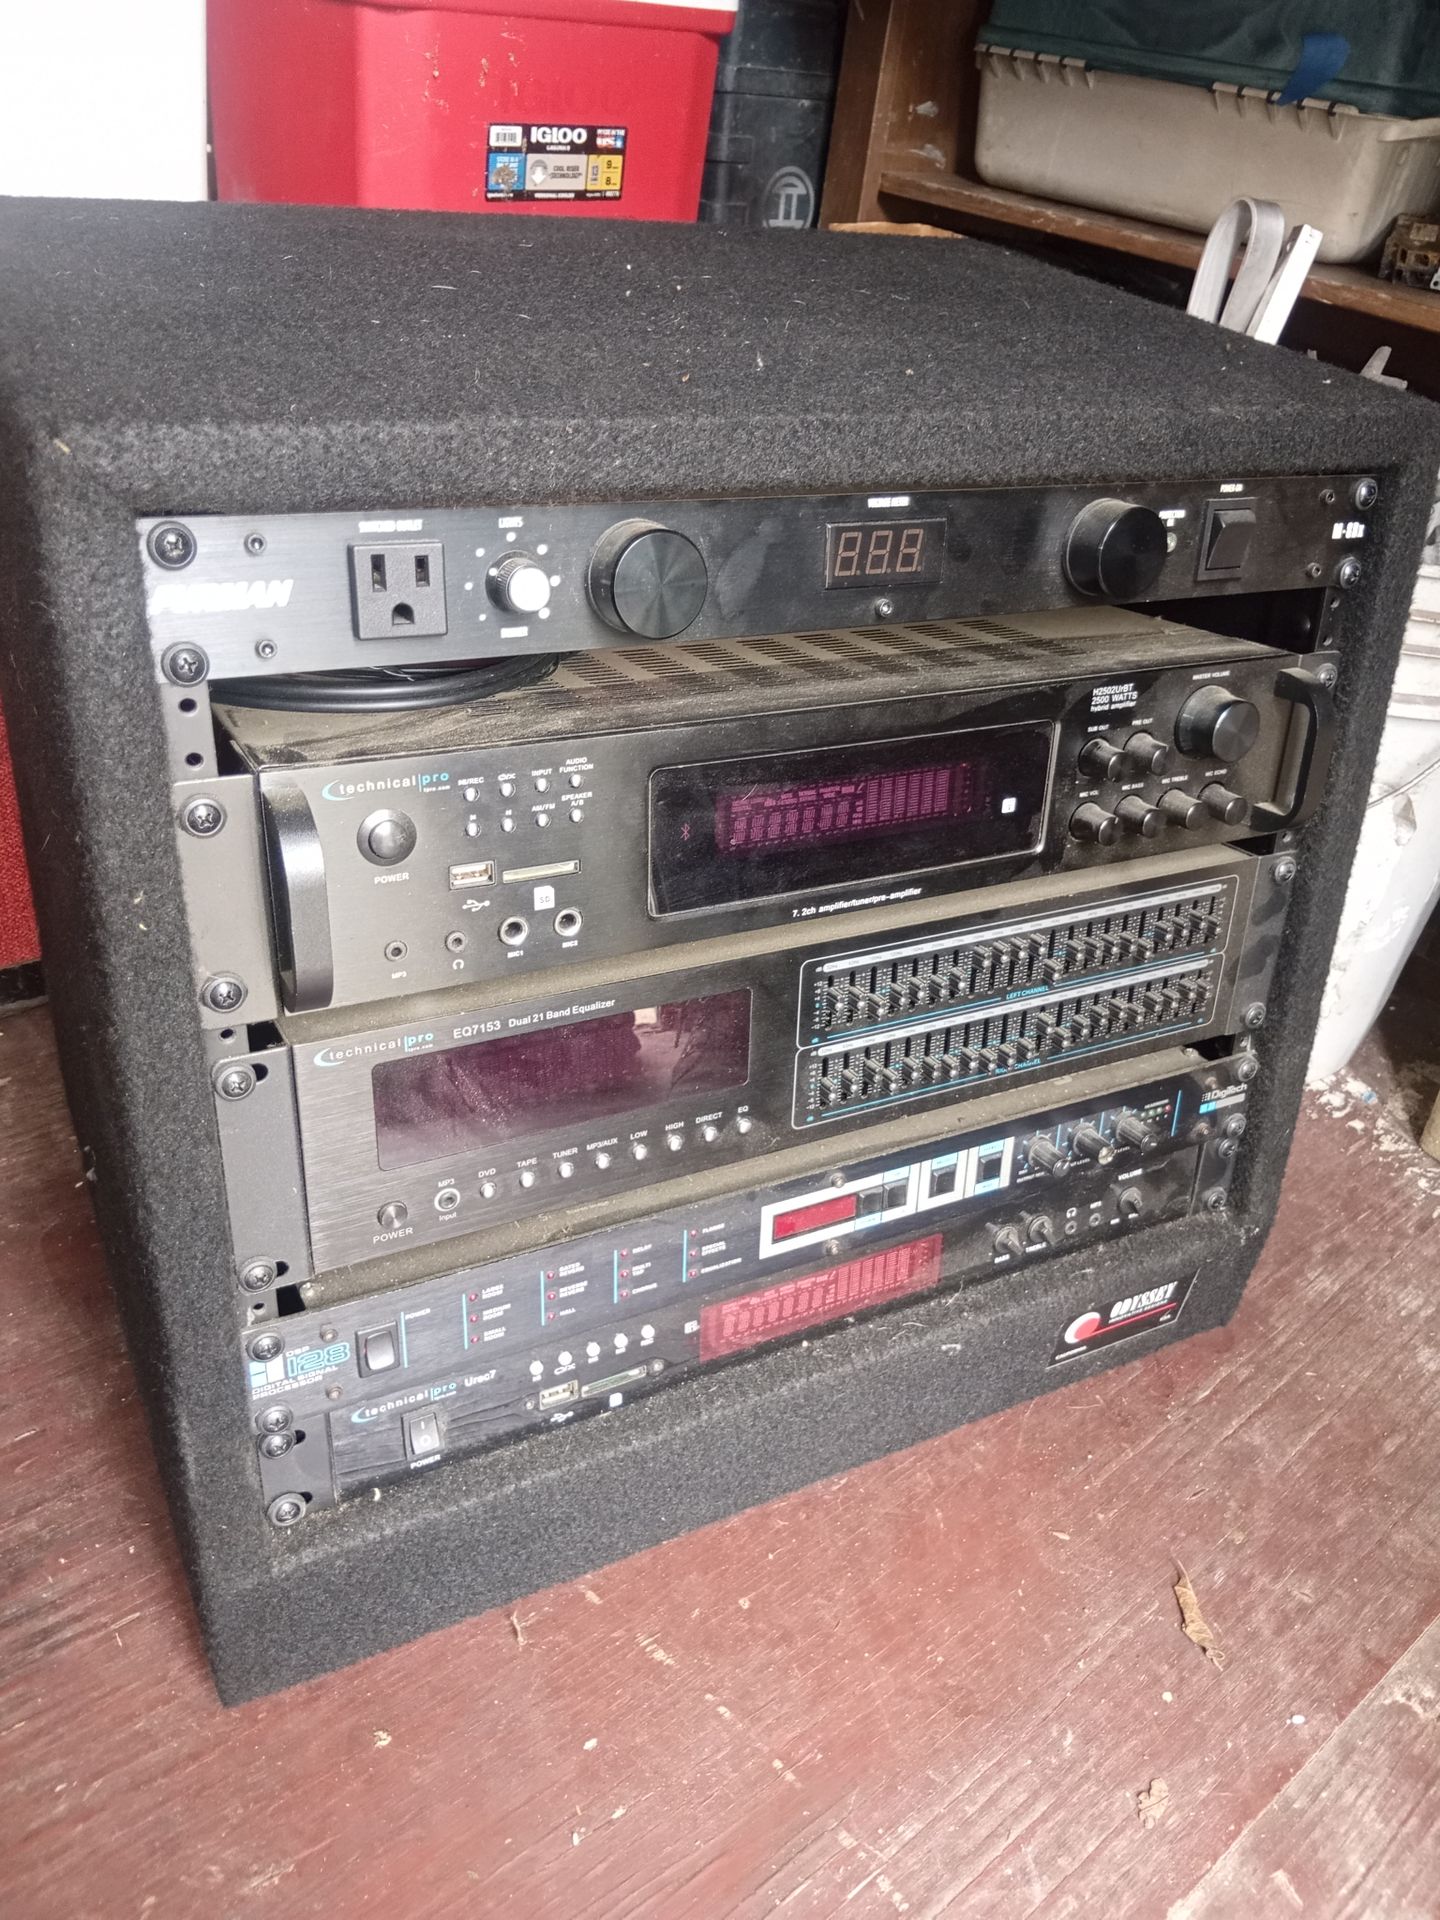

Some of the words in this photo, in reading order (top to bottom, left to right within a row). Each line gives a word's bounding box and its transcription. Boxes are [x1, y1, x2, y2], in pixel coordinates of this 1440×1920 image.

[530, 126, 588, 144] IGLOO
[606, 160, 613, 169] 9
[605, 177, 611, 186] 8
[1091, 694, 1110, 705] 2500
[1111, 691, 1138, 702] WATTS
[1090, 703, 1109, 712] hybrid
[1110, 700, 1137, 710] amplifier
[565, 757, 588, 765] AUDIO
[531, 768, 553, 777] INPUT
[559, 763, 594, 773] FUNCTION
[561, 791, 593, 801] SPEAKER
[374, 872, 410, 885] POWER
[801, 906, 816, 916] 2ch
[1006, 991, 1021, 1000] LEFT
[1021, 985, 1049, 996] CHANNEL
[508, 1015, 531, 1028] Dual
[532, 1012, 544, 1023] 21
[546, 1007, 571, 1020] Band
[571, 999, 616, 1017] Equalizer
[453, 1020, 501, 1039] EQ7153
[1211, 1082, 1248, 1100] DigiTech
[738, 1104, 749, 1114] EQ
[695, 1111, 723, 1125] DIRECT
[665, 1120, 685, 1131] HIGH
[629, 1130, 648, 1140] LOW
[585, 1136, 618, 1151] MP3/AUX
[552, 1147, 578, 1159] TUNER
[517, 1157, 538, 1168] TAPE
[478, 1167, 497, 1179] DVD
[1118, 1167, 1143, 1181] VOLUME
[437, 1178, 455, 1188] MP3
[438, 1211, 457, 1222] Input
[372, 1226, 413, 1244] POWER
[1109, 1280, 1178, 1319] ODYSSEY
[404, 1308, 431, 1320] POWER
[285, 1345, 310, 1358] DSP
[286, 1342, 351, 1378] 128
[251, 1378, 296, 1395] DIGITAL
[297, 1365, 339, 1381] SIGNAL
[251, 1374, 324, 1400] PROCESSOR
[410, 1454, 441, 1469] POWER
